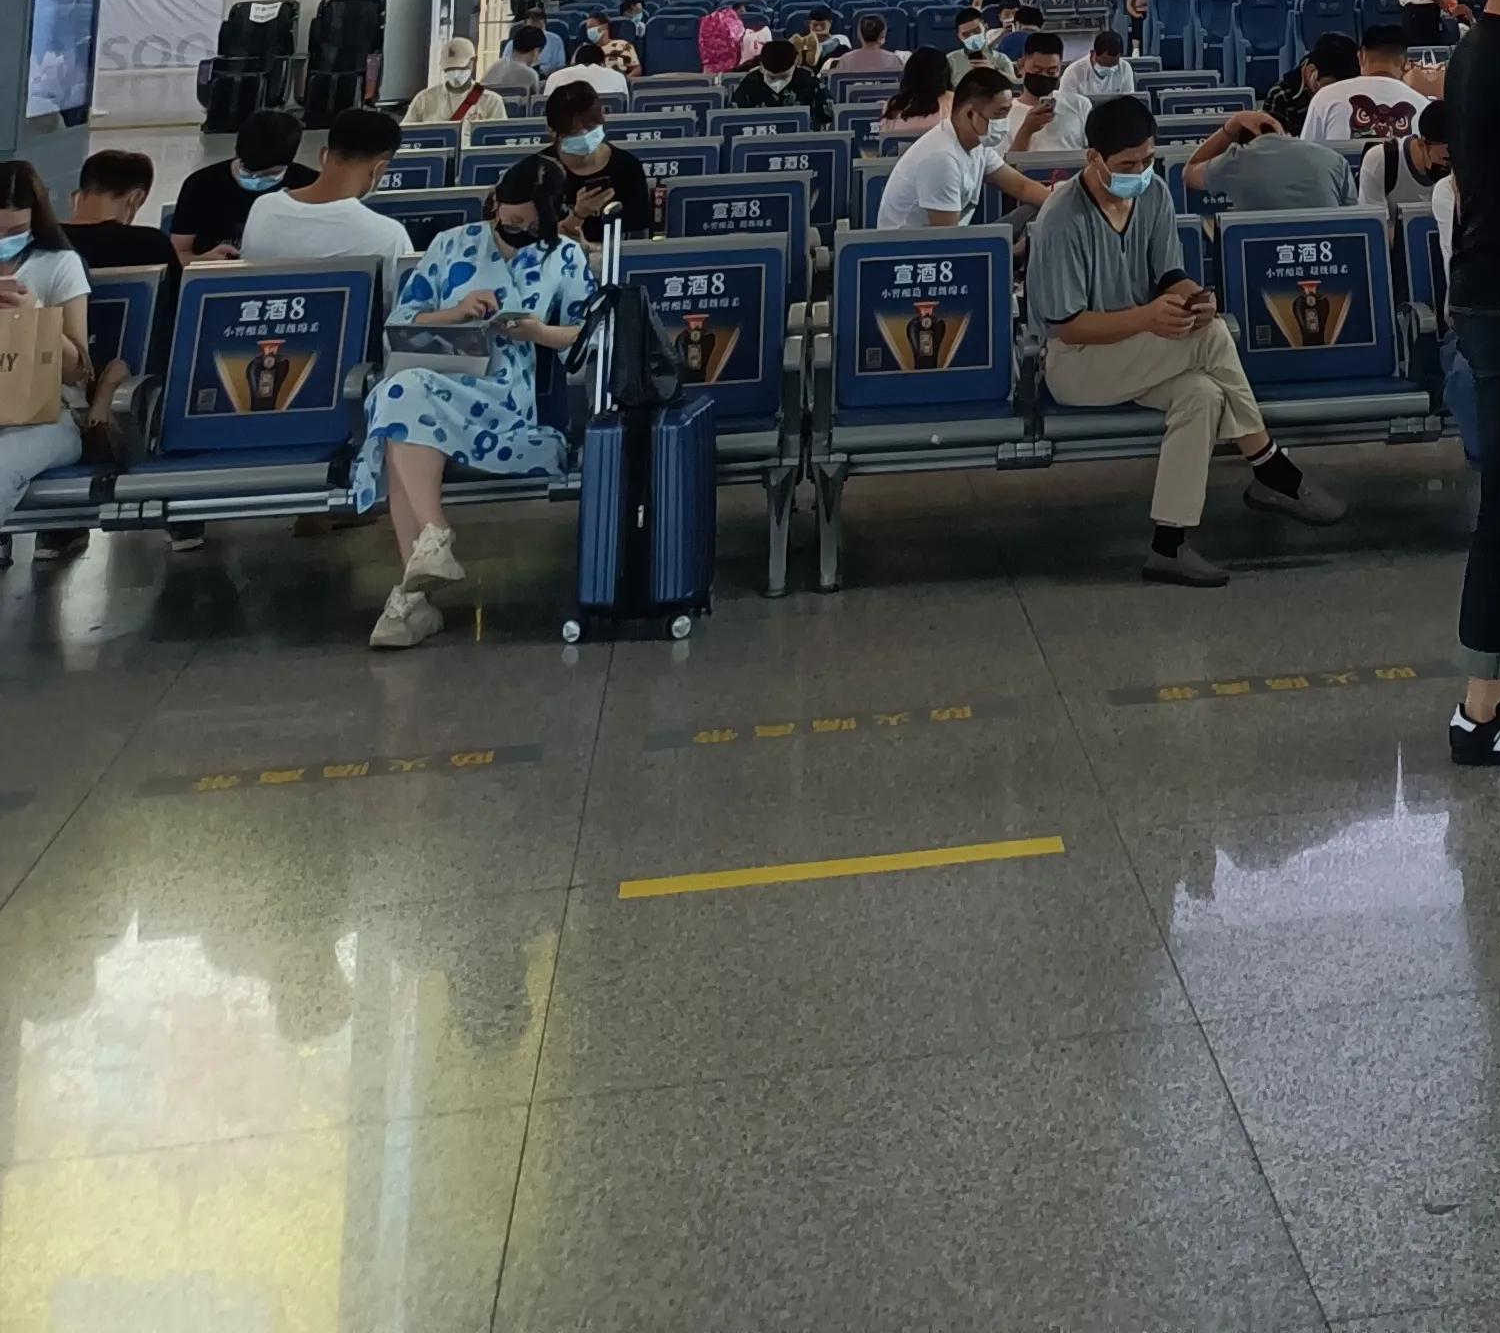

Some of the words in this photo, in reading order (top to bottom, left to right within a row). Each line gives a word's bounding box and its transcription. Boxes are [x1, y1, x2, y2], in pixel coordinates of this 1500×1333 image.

[769, 154, 809, 170] 宣酒8
[712, 199, 760, 219] 宣酒8
[1276, 240, 1333, 264] 宣酒8
[894, 260, 953, 284] 宣酒8
[664, 271, 724, 298] 宣酒8
[240, 296, 305, 322] 宣酒8
